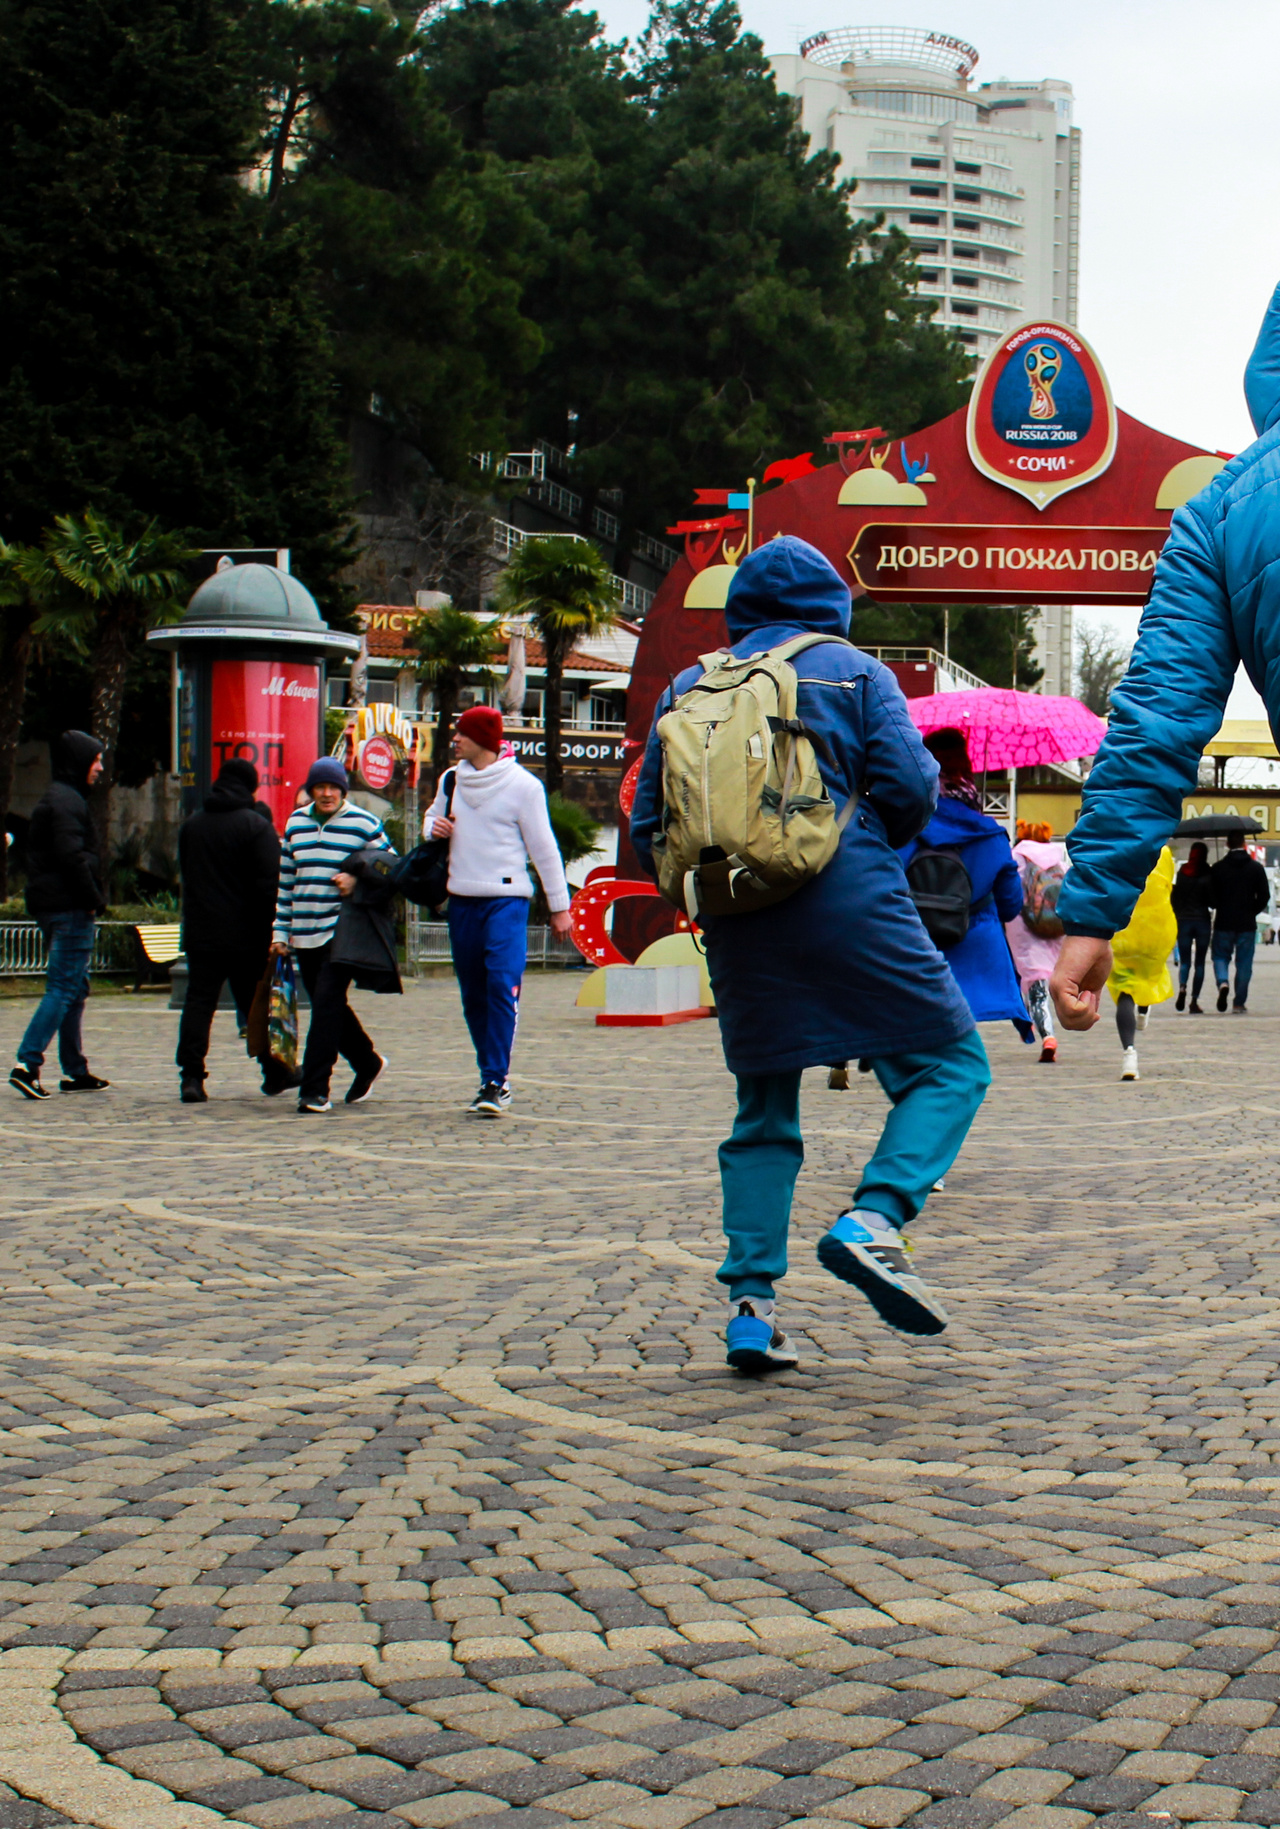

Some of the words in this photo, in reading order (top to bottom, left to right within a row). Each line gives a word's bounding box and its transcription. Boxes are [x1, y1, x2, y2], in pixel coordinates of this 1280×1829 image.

[1005, 430, 1049, 440] RUSSIA
[1050, 431, 1078, 441] 2018
[1016, 456, 1067, 471] СОЧИ
[876, 546, 979, 571] ДОБРО
[985, 547, 1162, 572] ПОЖАЛОВА
